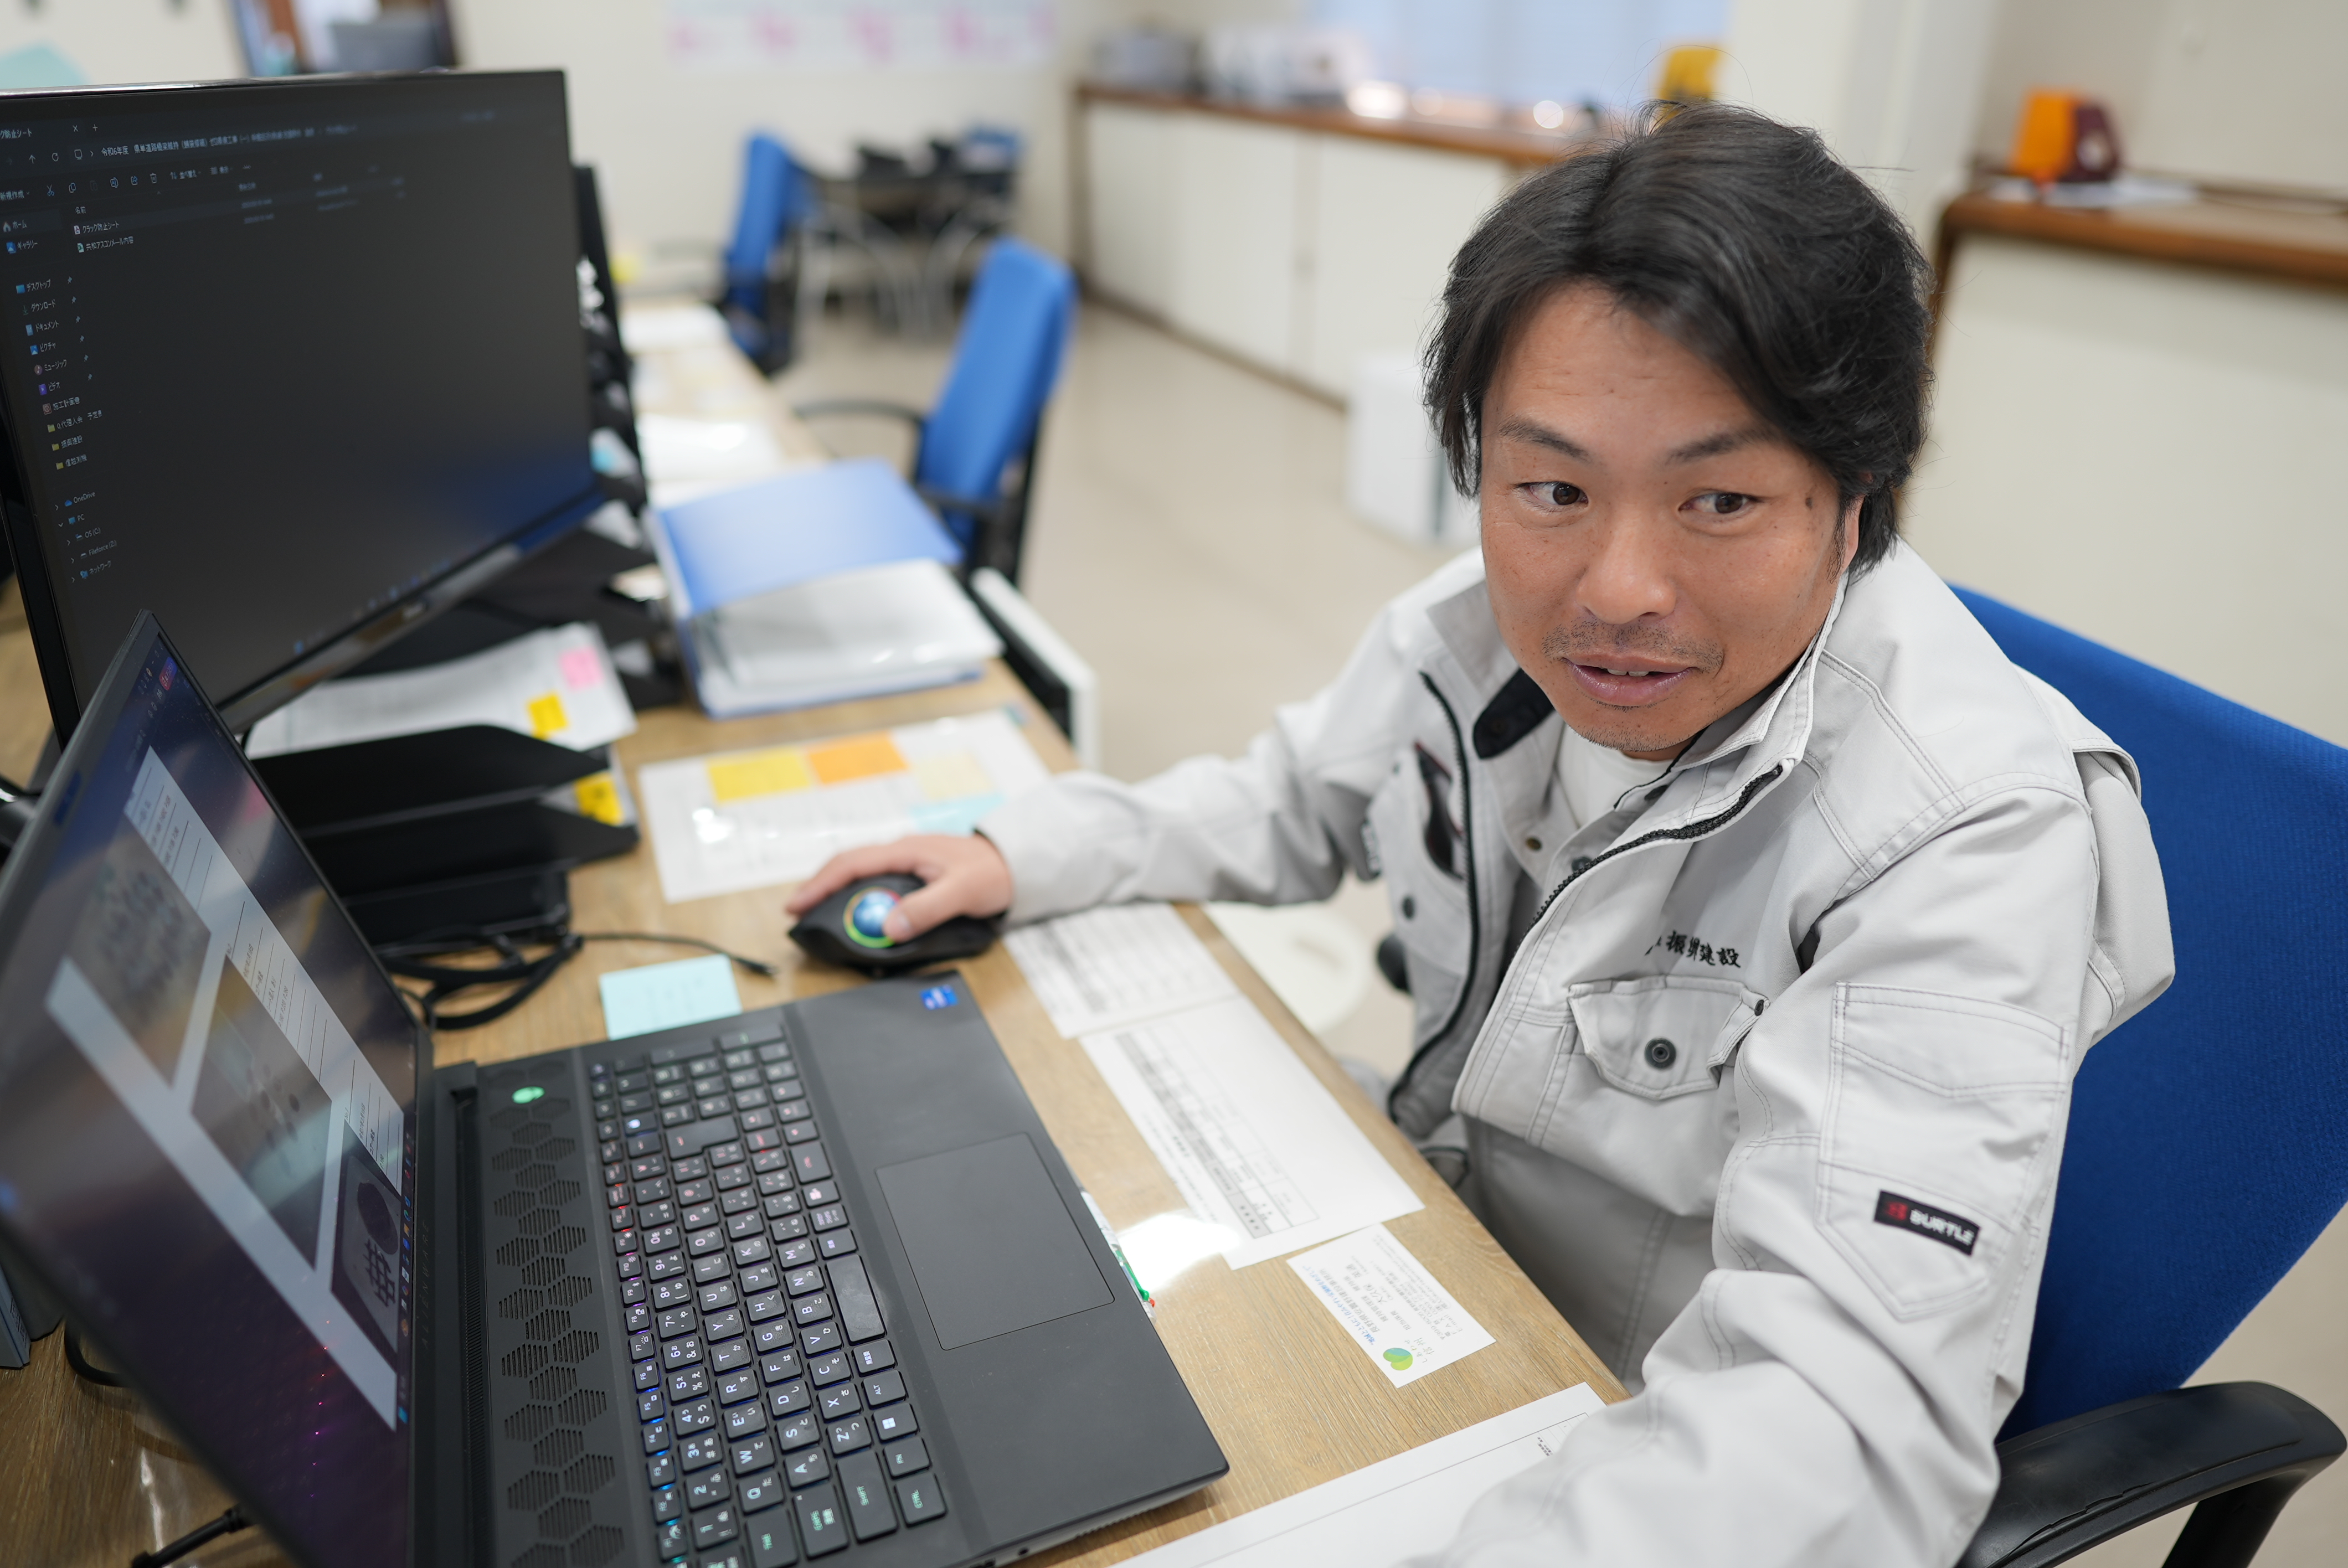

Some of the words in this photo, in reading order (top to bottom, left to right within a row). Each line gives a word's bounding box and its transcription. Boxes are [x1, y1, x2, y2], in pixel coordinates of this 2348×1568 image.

[75, 205, 86, 214] 名前
[13, 219, 27, 229] ホーム
[82, 221, 119, 234] クラック防止シート
[17, 239, 38, 250] ギャラリー
[26, 279, 52, 292] デスクトップ
[30, 300, 56, 312] ダウンロード
[35, 319, 59, 332] ドキュメント
[39, 341, 56, 353] ピクチャ
[44, 359, 68, 372] ミュージック
[48, 381, 60, 391] ビデオ
[73, 491, 96, 504] OneDrive
[77, 514, 85, 522] PC
[85, 529, 93, 538] OS
[89, 560, 112, 575] ネットワーク
[735, 1221, 745, 1230] L
[1910, 1209, 1974, 1246] BURTLE
[740, 1248, 752, 1256] K
[785, 1250, 797, 1260] M
[421, 1219, 430, 1350] ALIENWARE
[794, 1278, 804, 1286] N
[706, 1293, 717, 1302] U
[755, 1303, 765, 1312] H
[802, 1306, 812, 1314] B
[762, 1332, 773, 1340] G
[1413, 1337, 1435, 1356] 信州
[819, 1365, 830, 1374] C
[692, 1381, 702, 1391] %
[725, 1384, 738, 1393] R
[873, 1384, 882, 1395] ALT
[777, 1395, 789, 1404] D
[827, 1398, 840, 1407] X
[697, 1415, 710, 1424] $
[732, 1417, 745, 1426] E
[786, 1428, 797, 1438] S
[836, 1432, 850, 1442] Z
[688, 1448, 700, 1458] 3
[739, 1450, 753, 1464] W
[794, 1463, 808, 1473] A
[693, 1484, 707, 1495] 2
[747, 1487, 761, 1499] Q
